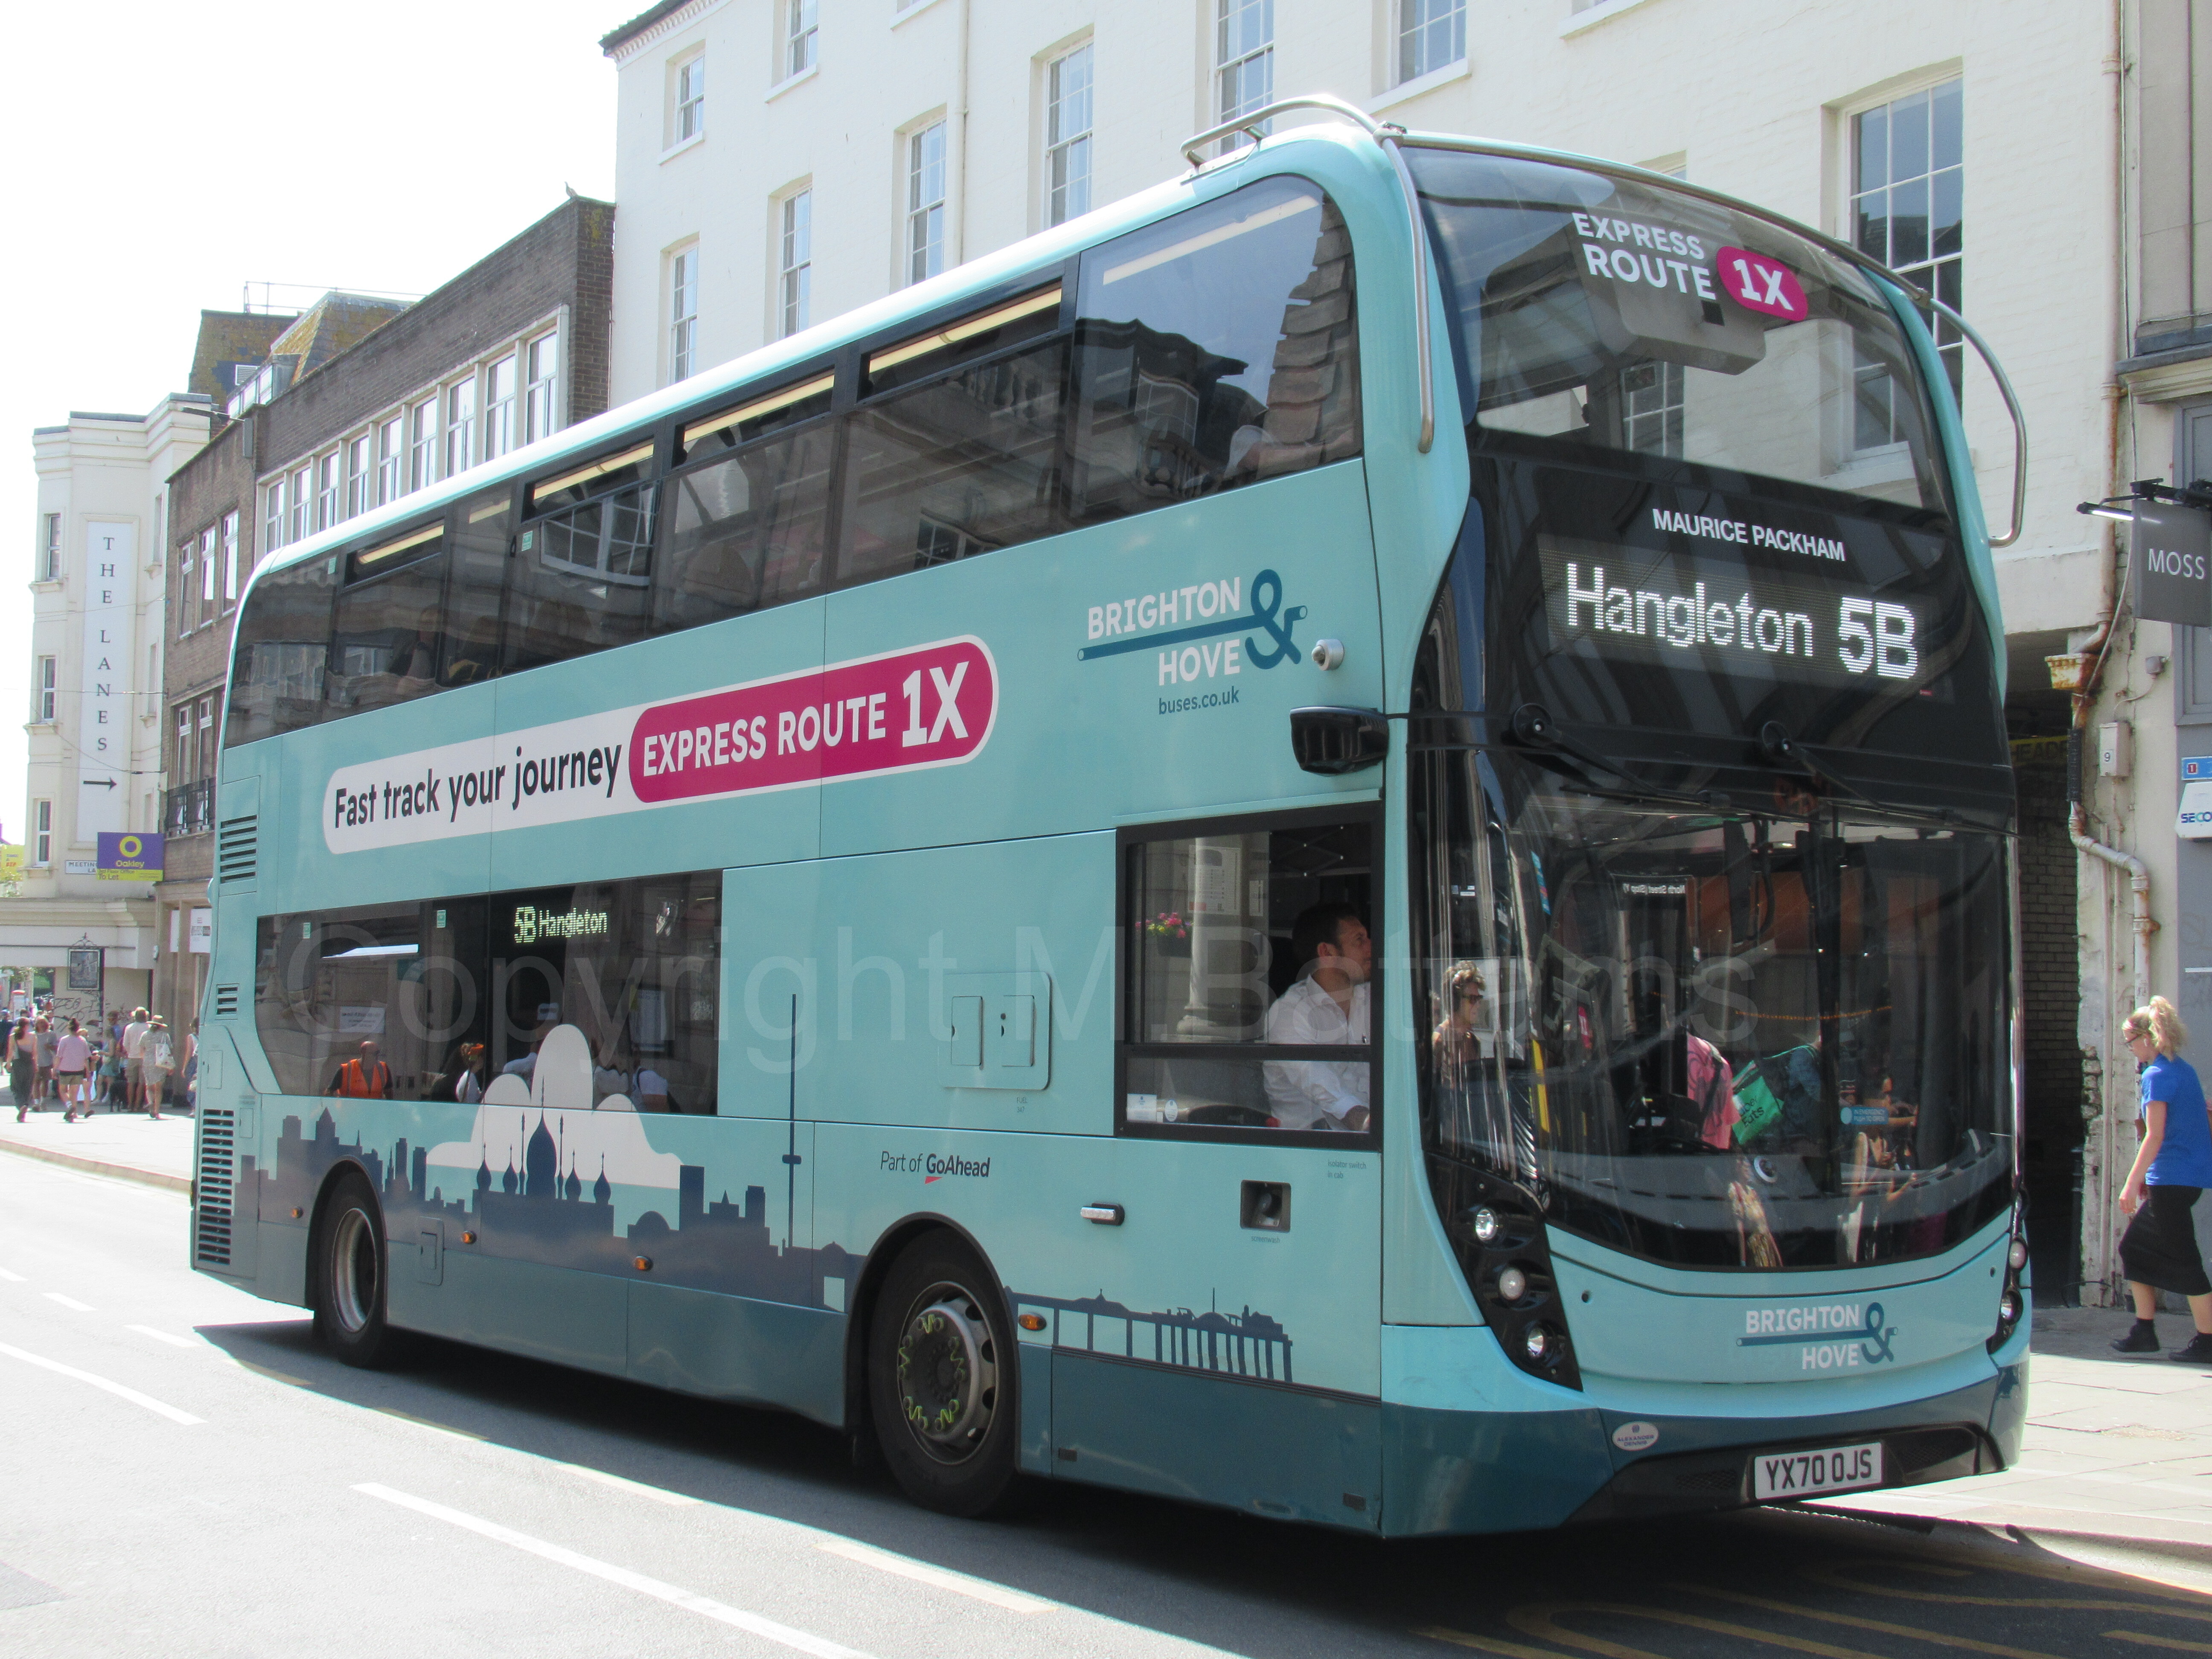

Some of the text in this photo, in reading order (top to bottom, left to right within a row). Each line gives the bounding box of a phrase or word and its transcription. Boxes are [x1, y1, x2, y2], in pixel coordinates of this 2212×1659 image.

[1572, 212, 1705, 260] EXPRESS
[1582, 243, 1794, 311] ROUTE 1X
[1652, 508, 1846, 562] MAURICE PACKHAM
[2148, 548, 2204, 580] MOSS
[1088, 577, 1240, 640] BRIGHTON
[1566, 562, 1918, 679] Hangleton 5B
[96, 536, 115, 751] THE LANES
[1158, 639, 1240, 686] HOVE
[1158, 686, 1240, 715] buses.co.uk
[335, 661, 970, 829] Fast track your journey EXPRESS ROUTE 1X
[2104, 752, 2111, 762] 9
[2181, 811, 2212, 824] SECO
[116, 860, 145, 869] Oakley
[514, 906, 607, 943] 5B Hangleton
[881, 1151, 991, 1178] Part of GoAhead
[1328, 1159, 1347, 1168] isolator
[1746, 1304, 1860, 1334] BRIGHTON
[1802, 1343, 1860, 1370] HOVE
[1765, 1449, 1872, 1490] YX70 OJS
